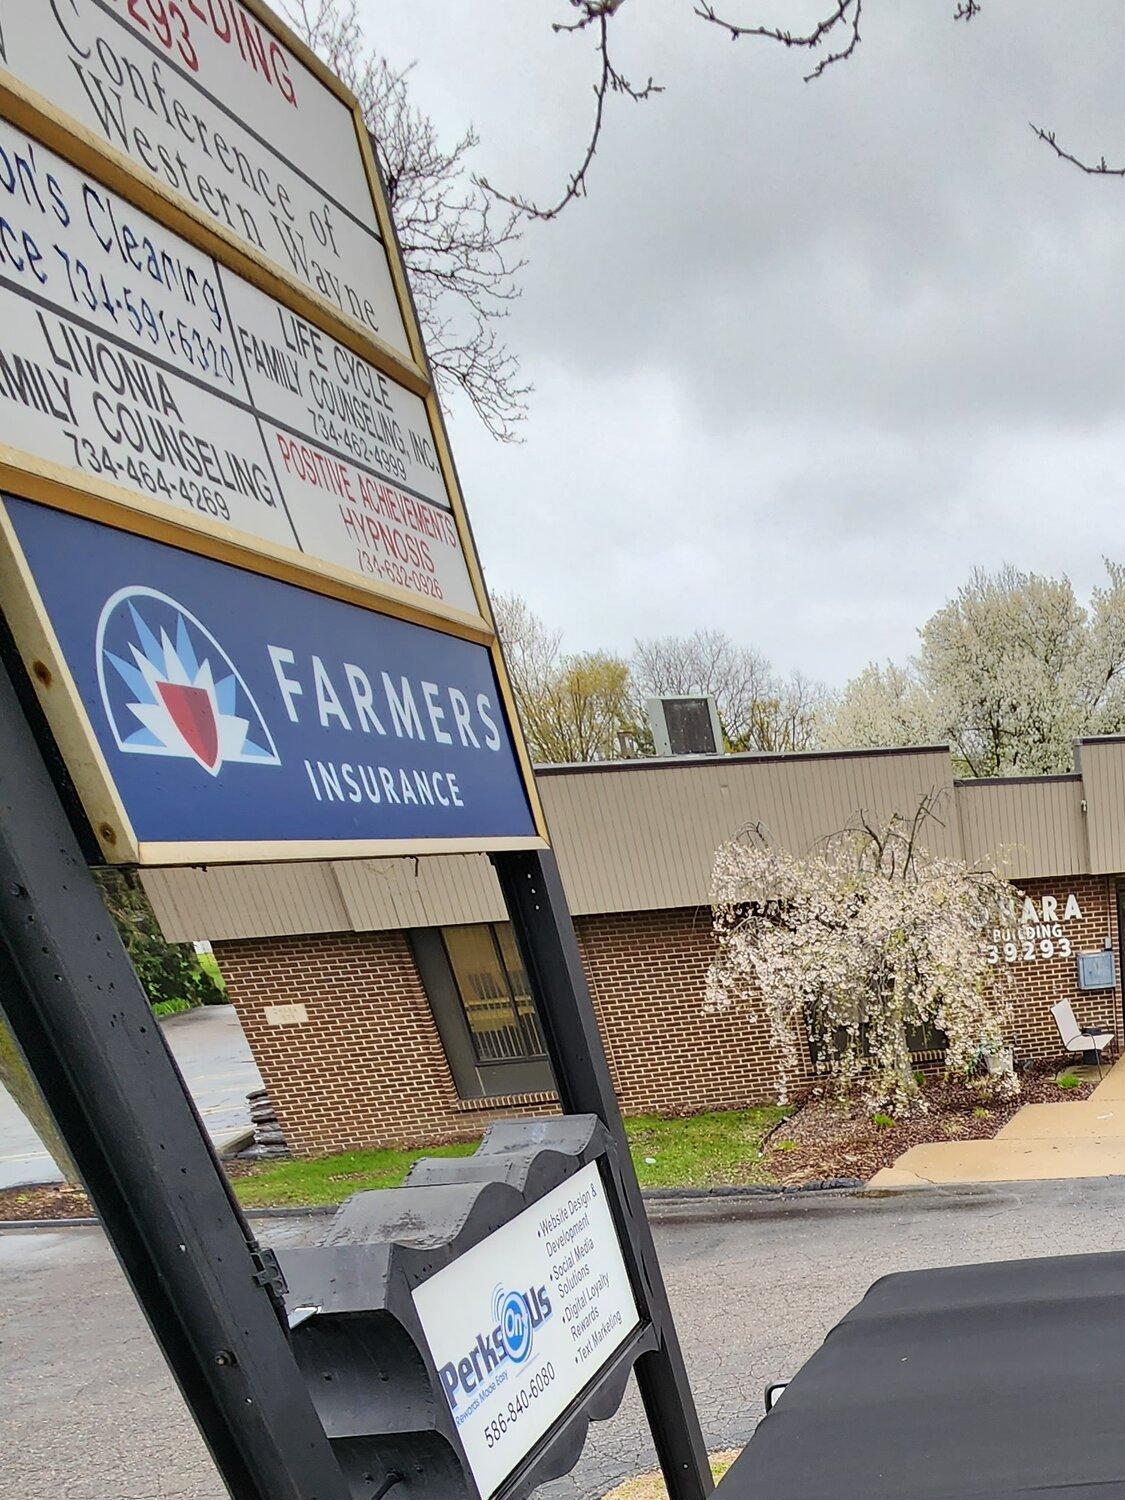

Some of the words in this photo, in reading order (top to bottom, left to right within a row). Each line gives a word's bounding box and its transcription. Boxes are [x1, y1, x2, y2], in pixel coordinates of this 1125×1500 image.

[52, 0, 295, 221] Conference
[309, 204, 341, 258] of
[68, 54, 266, 252] Western
[269, 211, 379, 332] Wayne
[0, 216, 48, 285] ce
[36, 309, 184, 423] LIVONIA
[277, 306, 328, 371] LIFE
[334, 345, 394, 412] CYCLE
[0, 349, 79, 426] MILY
[92, 391, 277, 507] COUNSELING
[238, 325, 303, 397] FAMILY
[408, 429, 440, 475] INC.
[63, 430, 231, 521] 734-464-4269
[307, 407, 406, 481] 734-462-4999
[276, 432, 356, 503] POSITIVE
[357, 473, 456, 548] ACHIEVEMENTS
[338, 504, 435, 573] HYPNOSIS
[357, 549, 443, 599] 734-632-0926
[267, 644, 501, 752] FARMERS
[304, 759, 464, 807] INSURANCE
[986, 937, 1073, 965] 39293
[993, 921, 1063, 943] BUILDING
[540, 1208, 570, 1237] Website
[567, 1191, 591, 1215] Design
[590, 1182, 598, 1198] &
[545, 1212, 591, 1258] Development
[552, 1251, 576, 1280] Social
[573, 1237, 595, 1263] Media
[557, 1263, 591, 1299] Solutions
[564, 1290, 587, 1322] Digital
[585, 1272, 611, 1301] Loyalty
[570, 1306, 600, 1341] Rewards
[439, 1325, 509, 1410] Perks
[523, 1285, 552, 1328] Us
[577, 1337, 594, 1362] Text
[591, 1310, 623, 1348] Marketing
[484, 1361, 556, 1449] 586-840-6080
